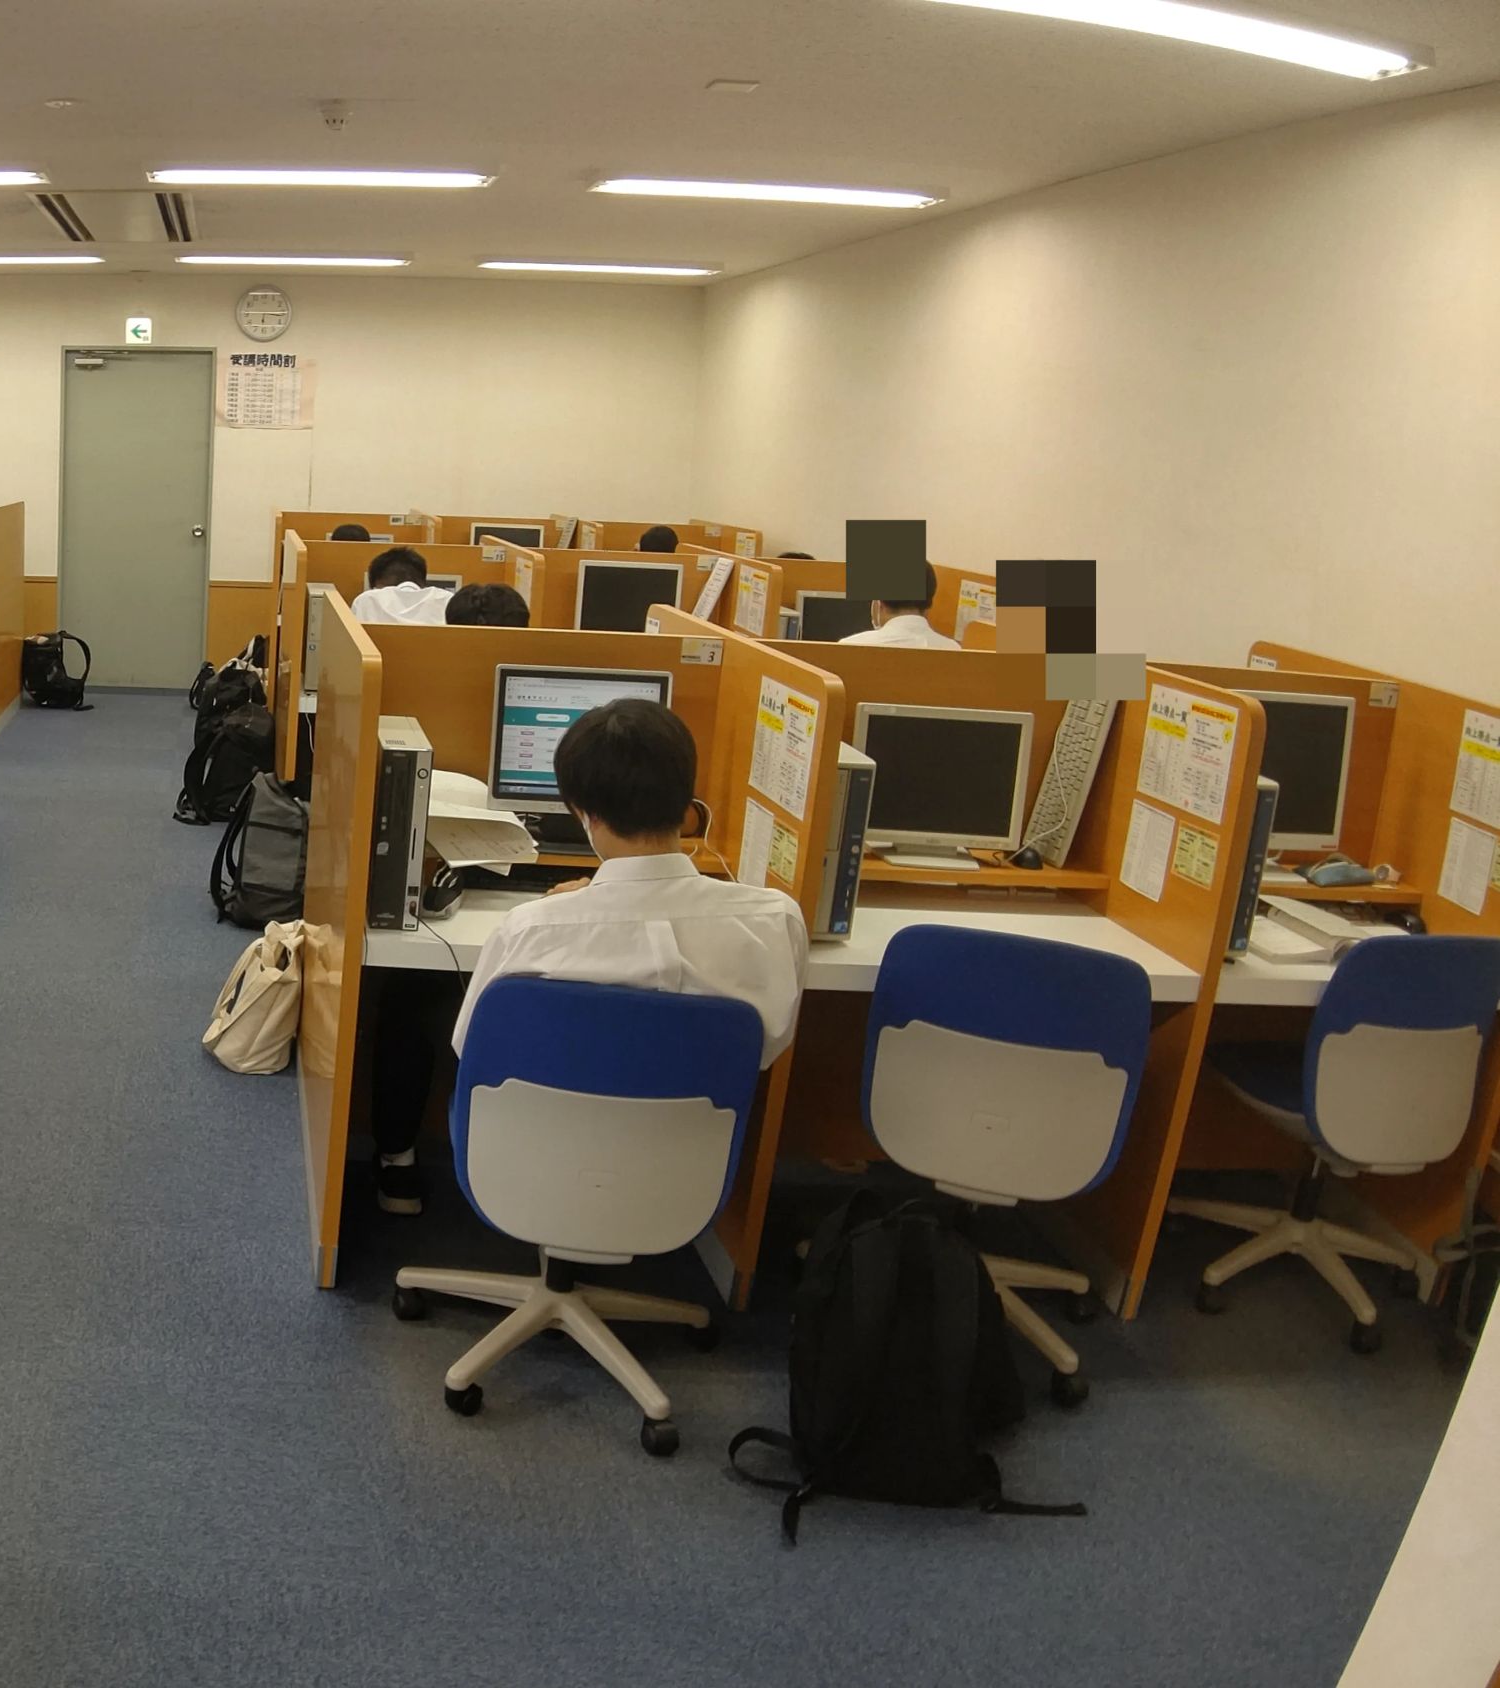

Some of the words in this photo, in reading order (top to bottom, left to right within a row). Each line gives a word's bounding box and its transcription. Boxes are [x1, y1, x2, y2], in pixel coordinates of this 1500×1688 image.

[230, 353, 296, 368] 受講時間割
[707, 651, 715, 662] 3
